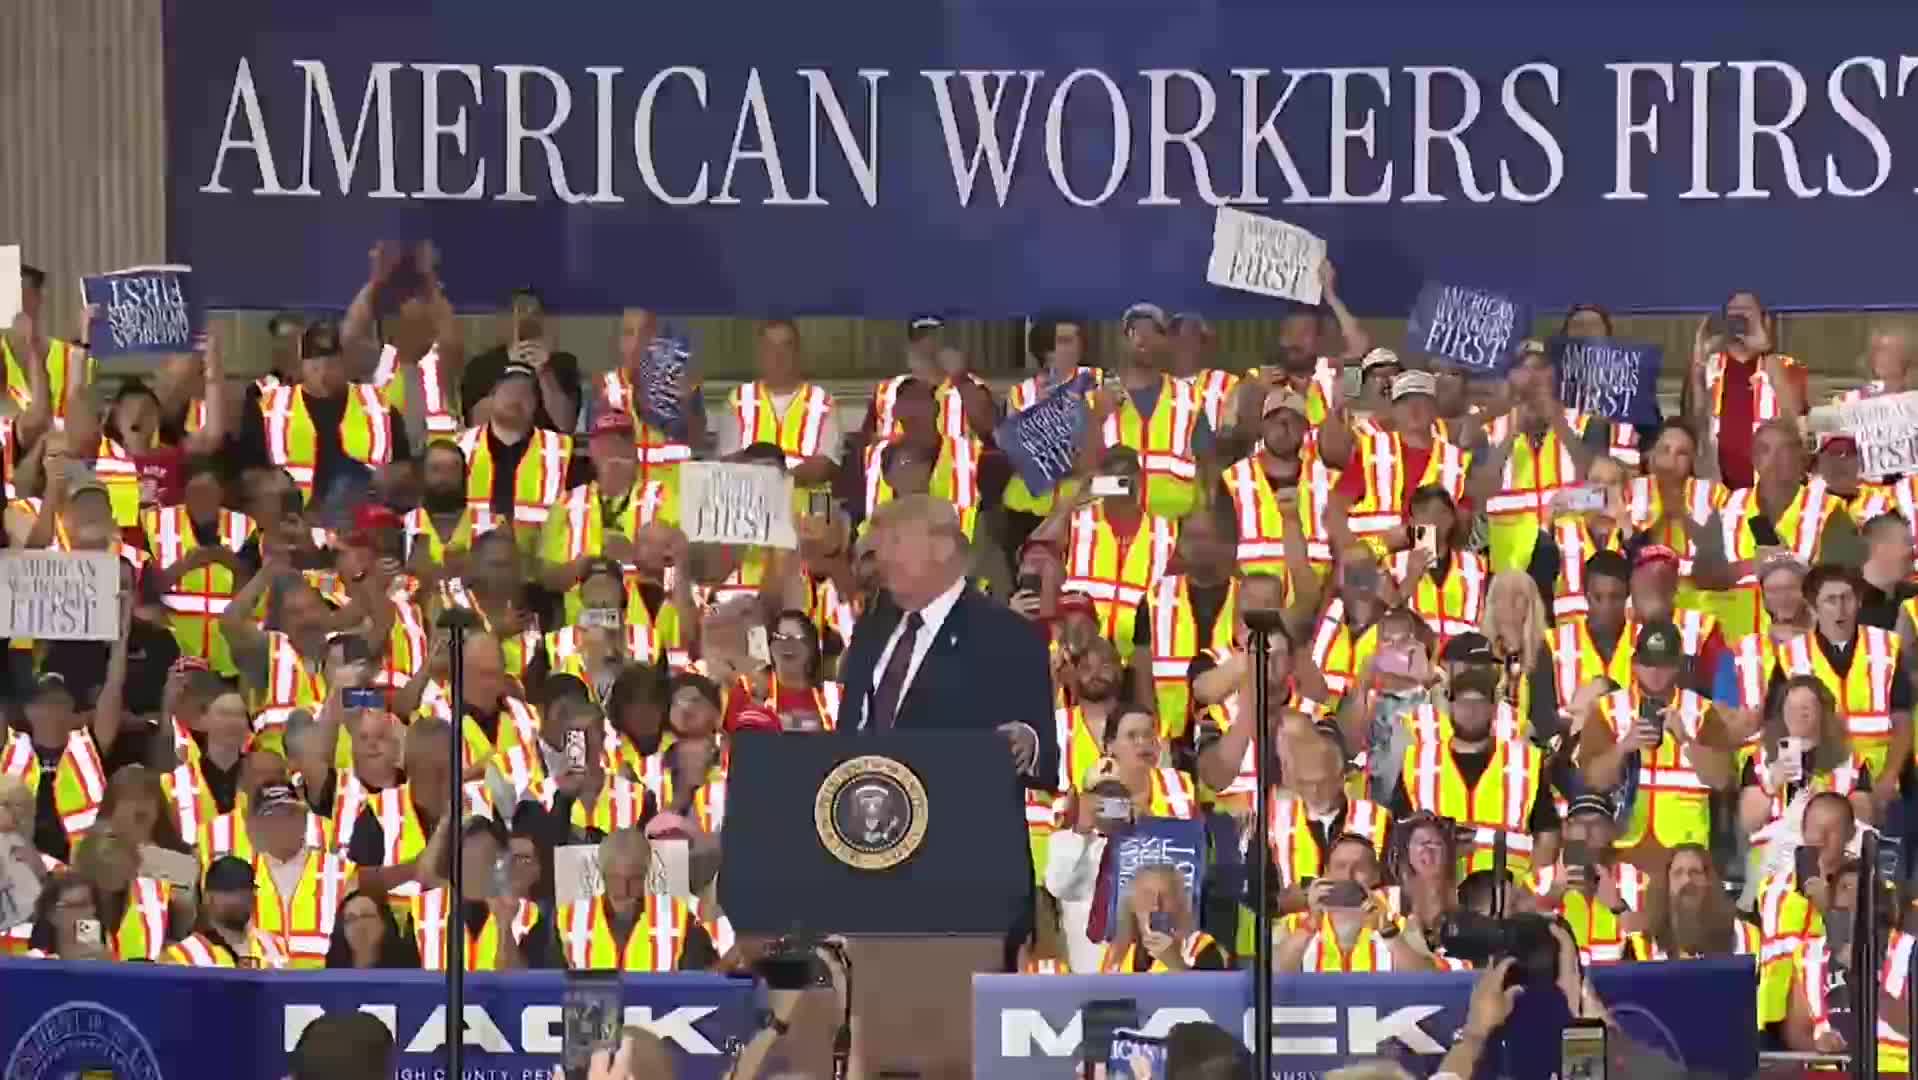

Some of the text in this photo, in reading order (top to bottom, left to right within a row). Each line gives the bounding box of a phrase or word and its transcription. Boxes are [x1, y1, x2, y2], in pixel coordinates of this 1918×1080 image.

[200, 56, 888, 207] AMERICAN
[919, 63, 1564, 208] WORKERS
[1424, 319, 1508, 368] FIRST
